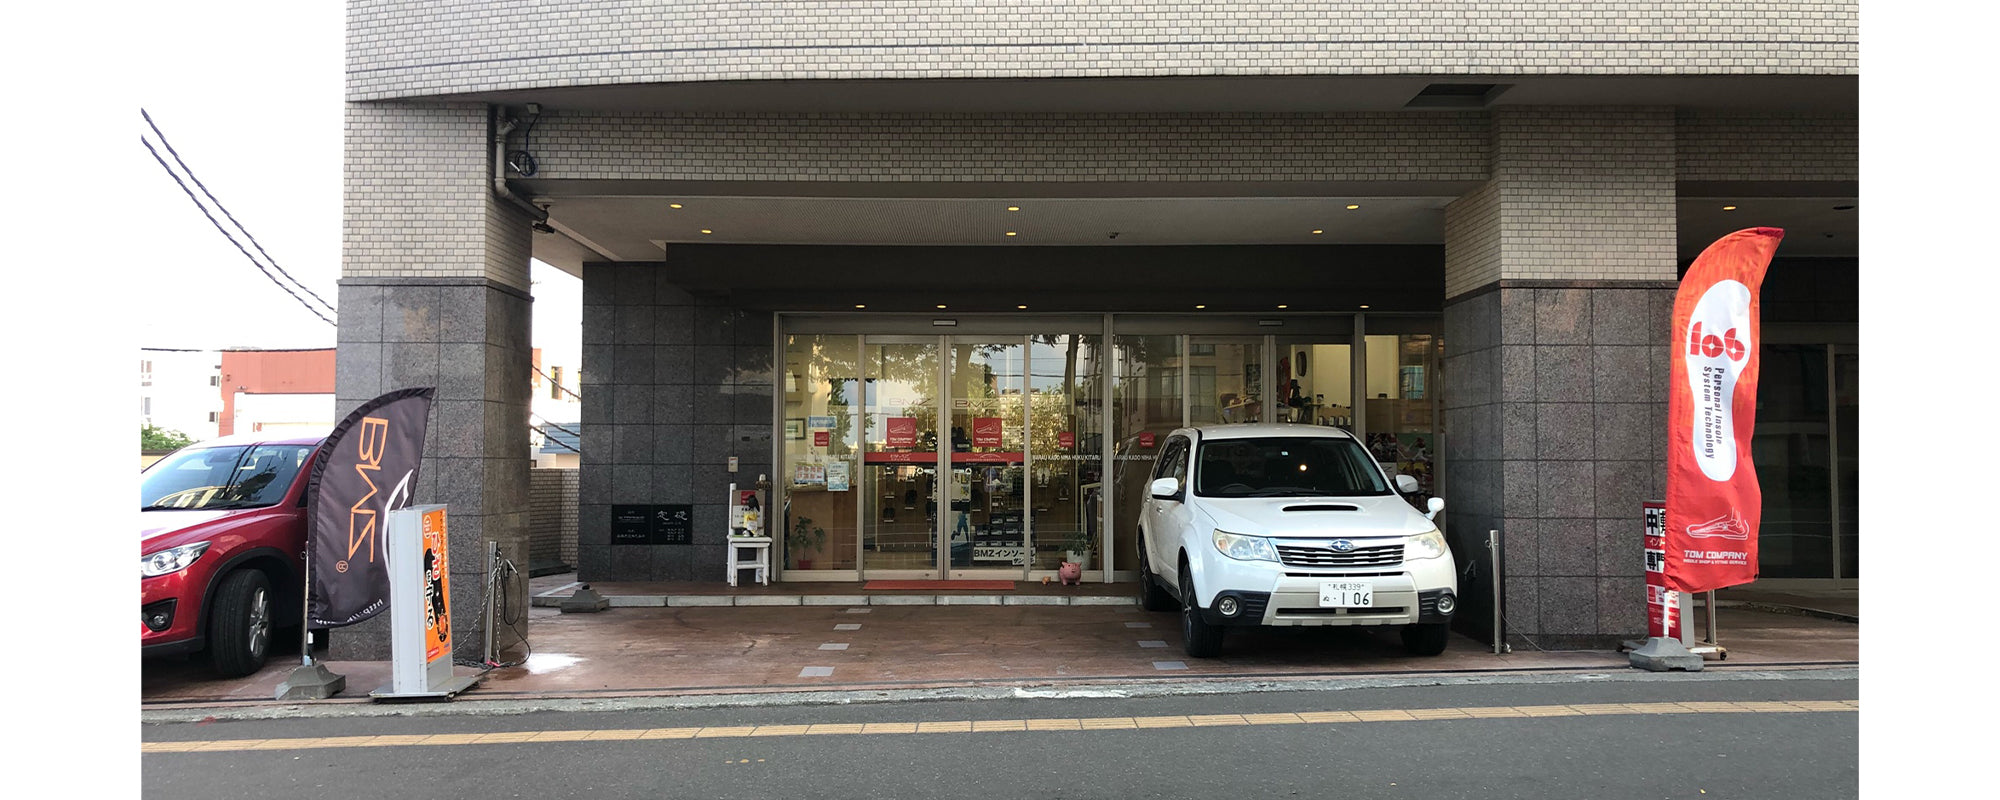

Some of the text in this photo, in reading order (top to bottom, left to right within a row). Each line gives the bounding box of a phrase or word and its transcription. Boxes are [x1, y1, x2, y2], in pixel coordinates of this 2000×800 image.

[1702, 366, 1715, 460] System Technology
[1713, 367, 1725, 445] Personal Insole
[1684, 550, 1748, 560] TOM COMPANY
